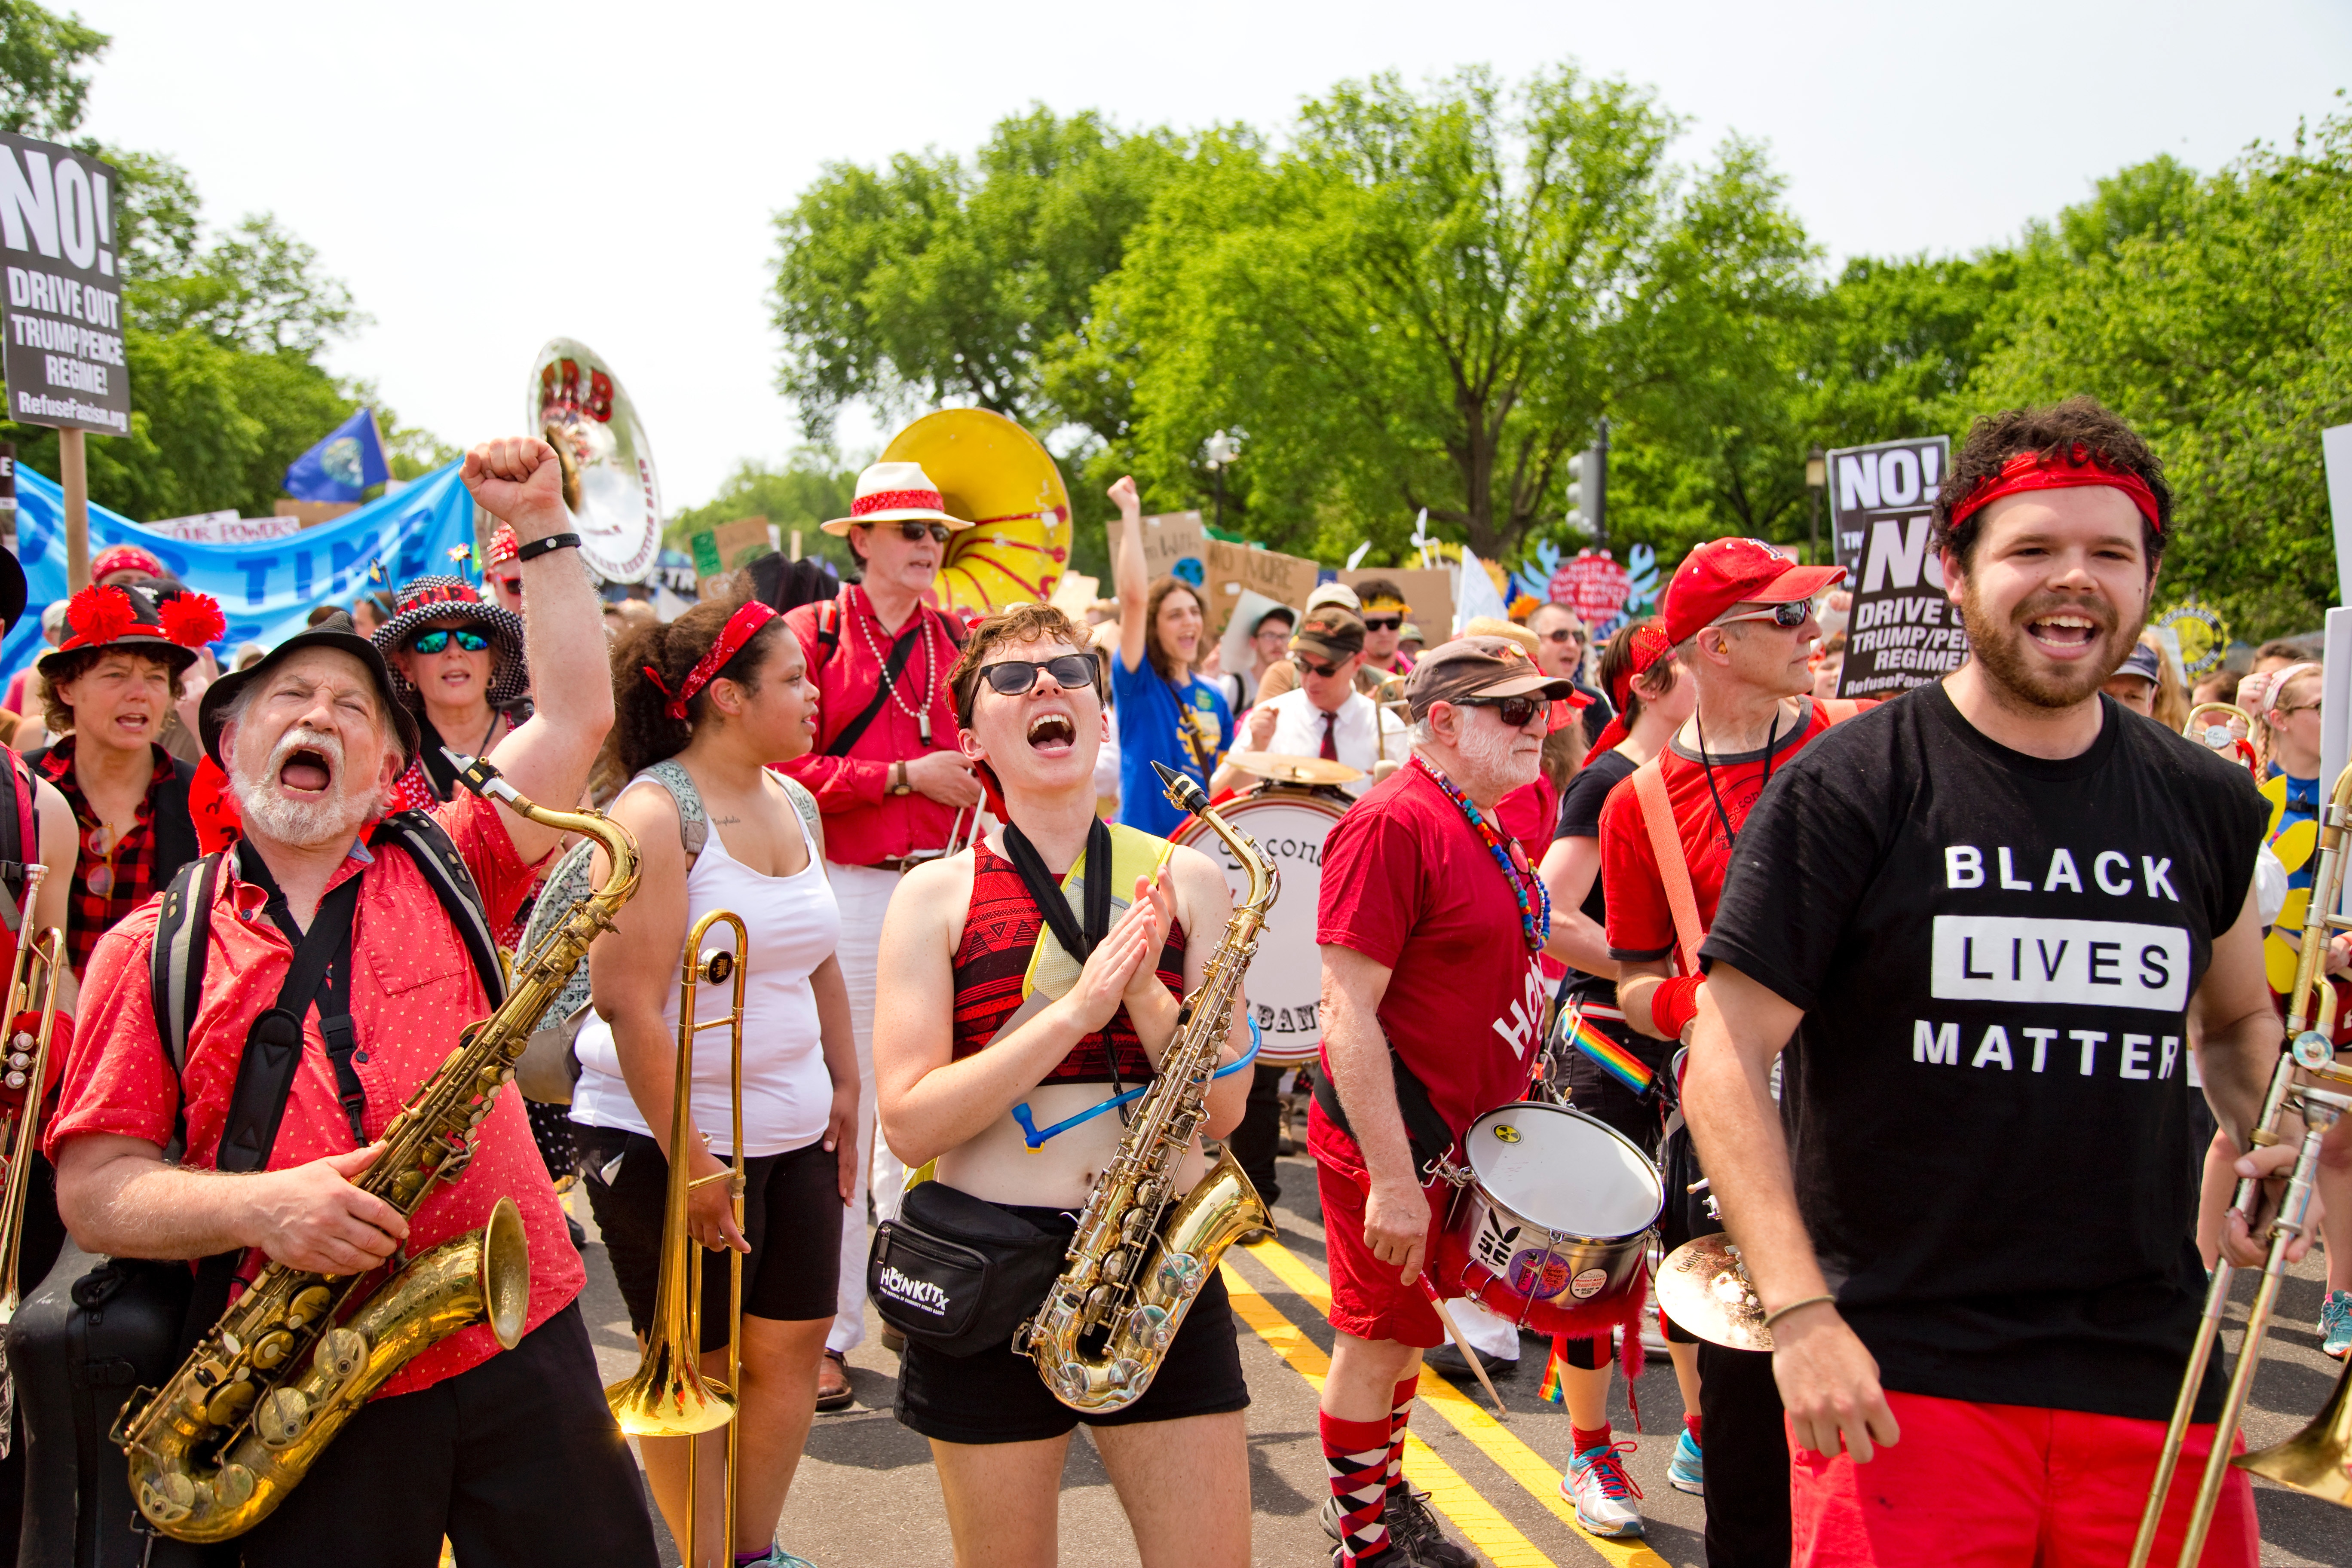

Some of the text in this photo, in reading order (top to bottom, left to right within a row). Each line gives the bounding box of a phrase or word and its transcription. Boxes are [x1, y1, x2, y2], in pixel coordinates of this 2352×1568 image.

[0, 144, 114, 277] NO!
[6, 266, 119, 330] DRIVE OUT
[11, 313, 125, 367] TRUMP/PENCE
[45, 354, 108, 396] REGIME!
[18, 391, 127, 432] RefuseFascism.org
[1838, 446, 1939, 512] NO!
[235, 508, 435, 606] TIME
[1855, 596, 1944, 631] DRIVE
[1945, 845, 2179, 902] BLACK
[1962, 936, 2170, 989] LIVES
[1912, 1019, 2180, 1081] MATTER
[1676, 1250, 1706, 1273] CLASSICS
